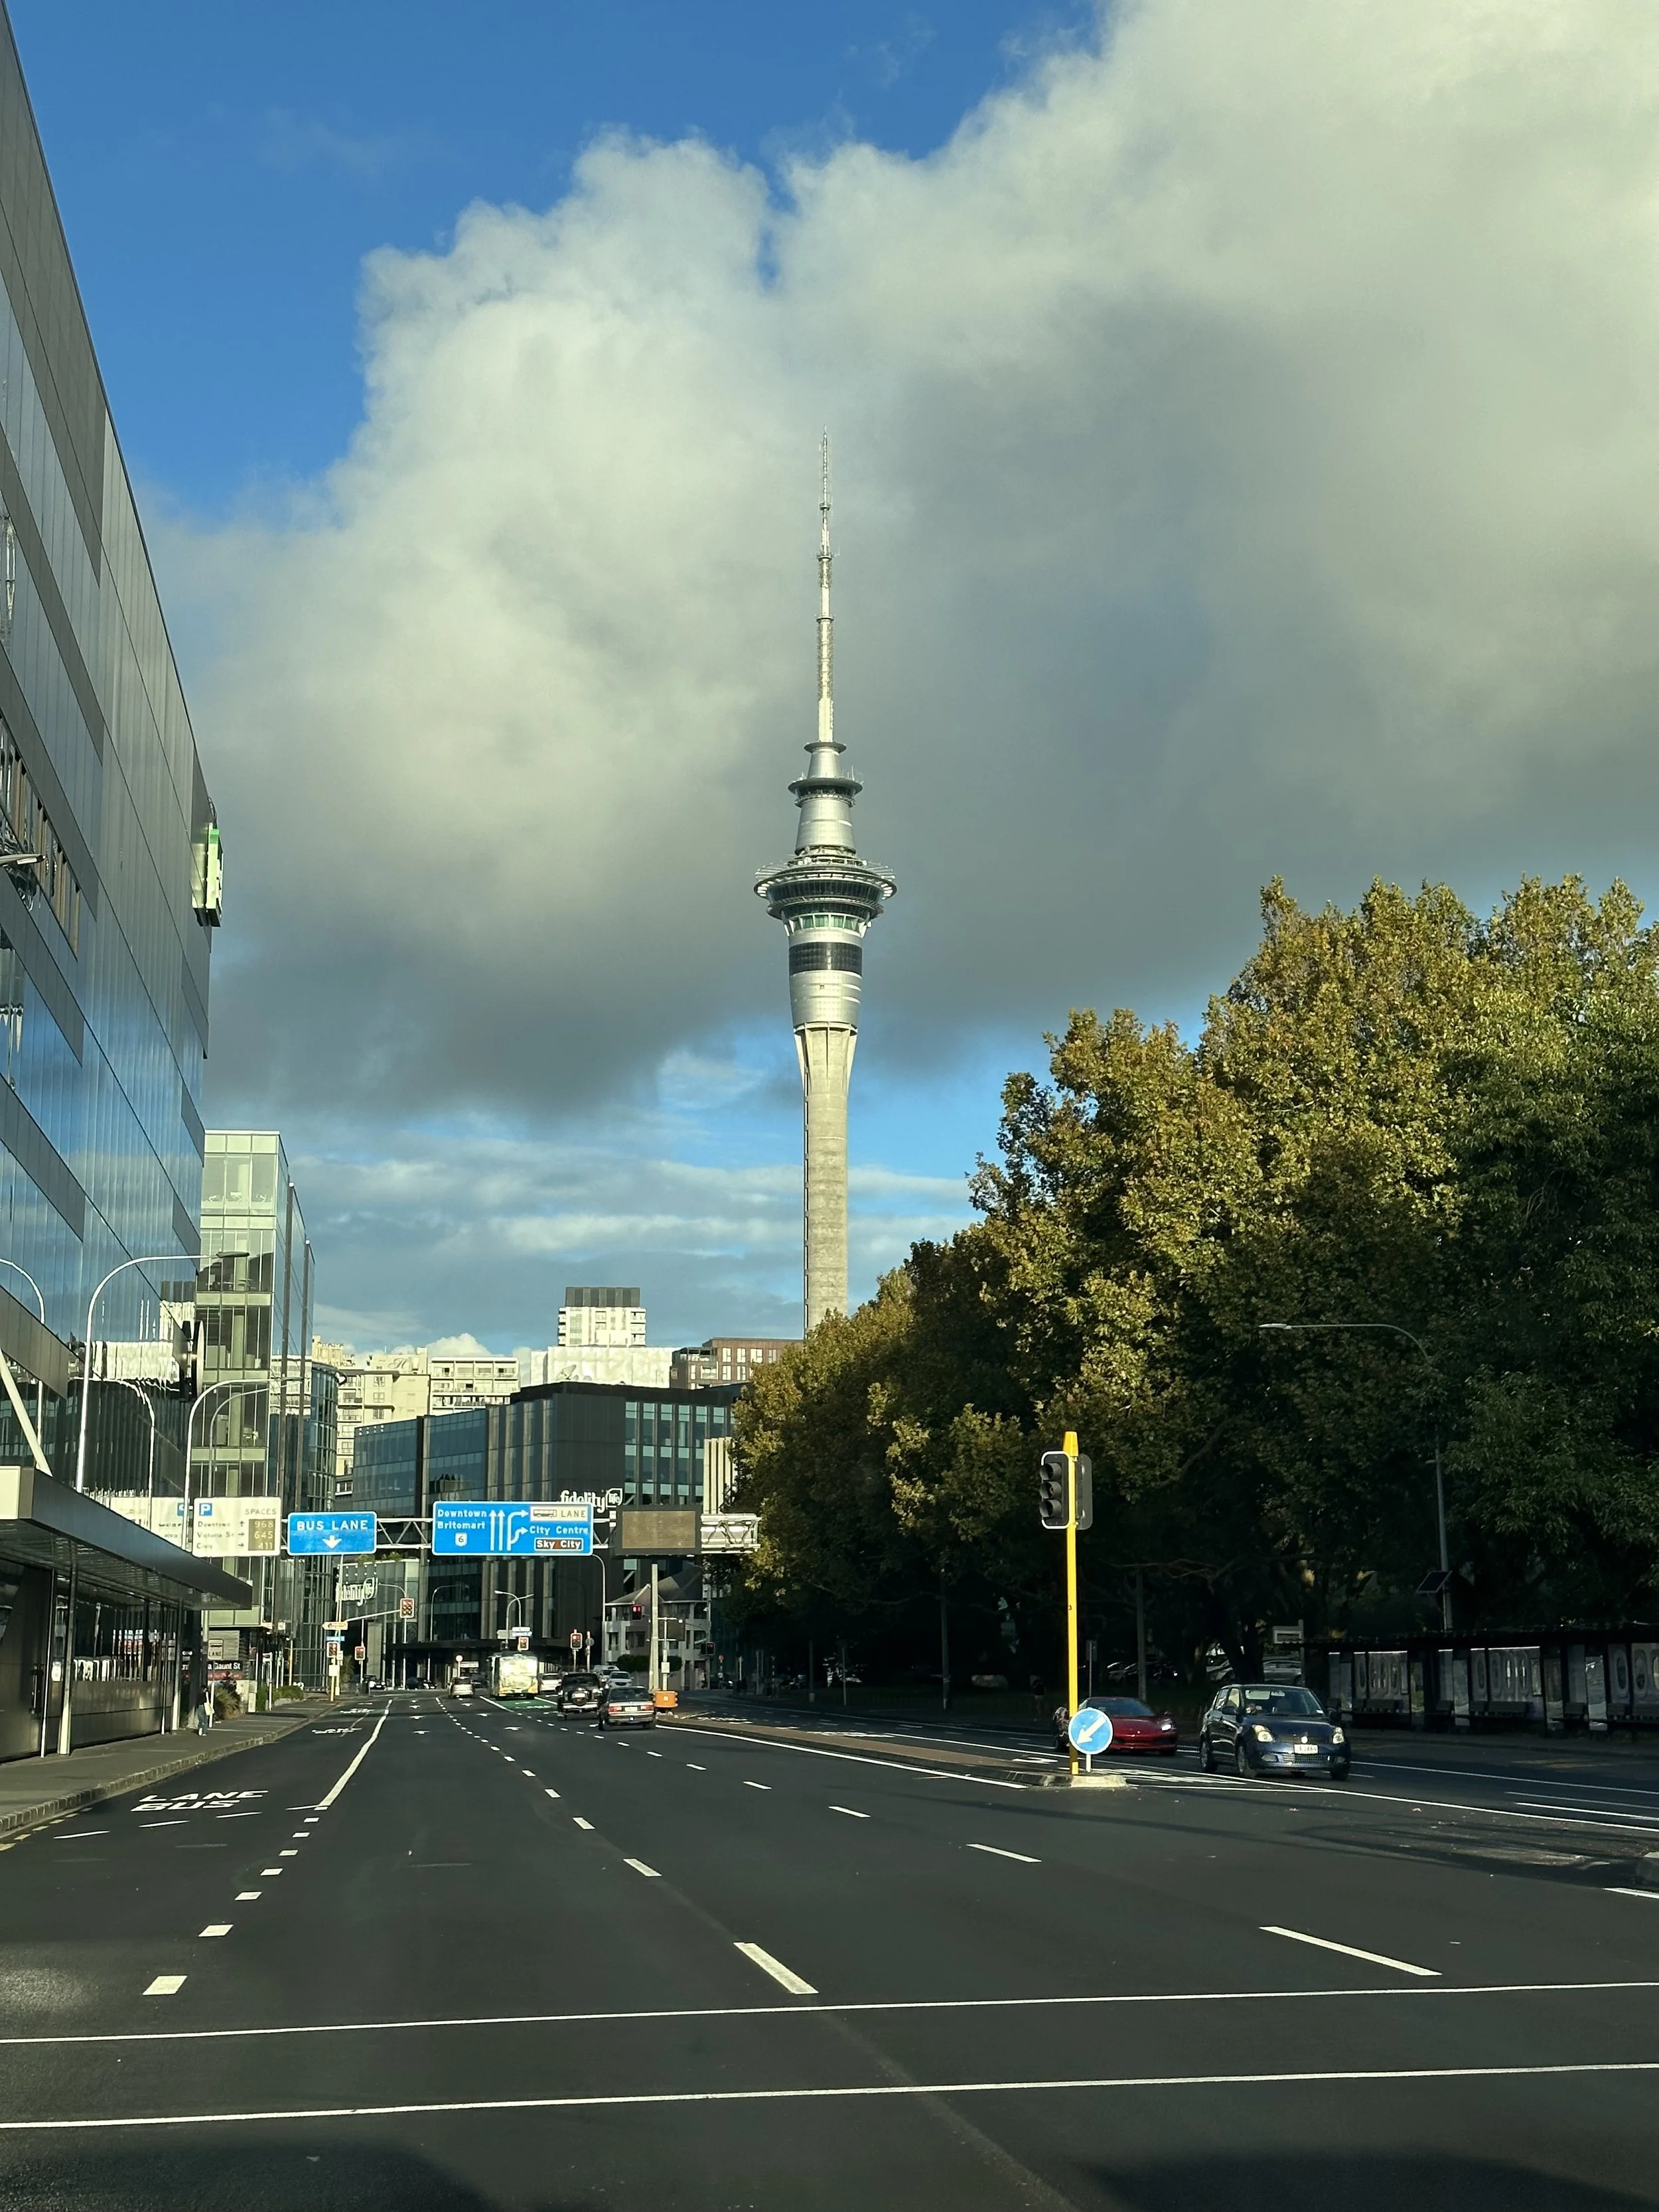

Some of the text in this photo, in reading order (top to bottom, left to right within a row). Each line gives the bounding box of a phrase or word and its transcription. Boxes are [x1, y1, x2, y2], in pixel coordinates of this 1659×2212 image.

[437, 1509, 487, 1518] Downtown
[297, 1520, 368, 1531] BUS LANE
[437, 1520, 486, 1529] Britomart
[254, 1530, 273, 1539] 645
[530, 1526, 589, 1535] City Centre
[536, 1540, 581, 1549] Sky City
[139, 1790, 269, 1802] LANE
[131, 1800, 240, 1812] BUS
